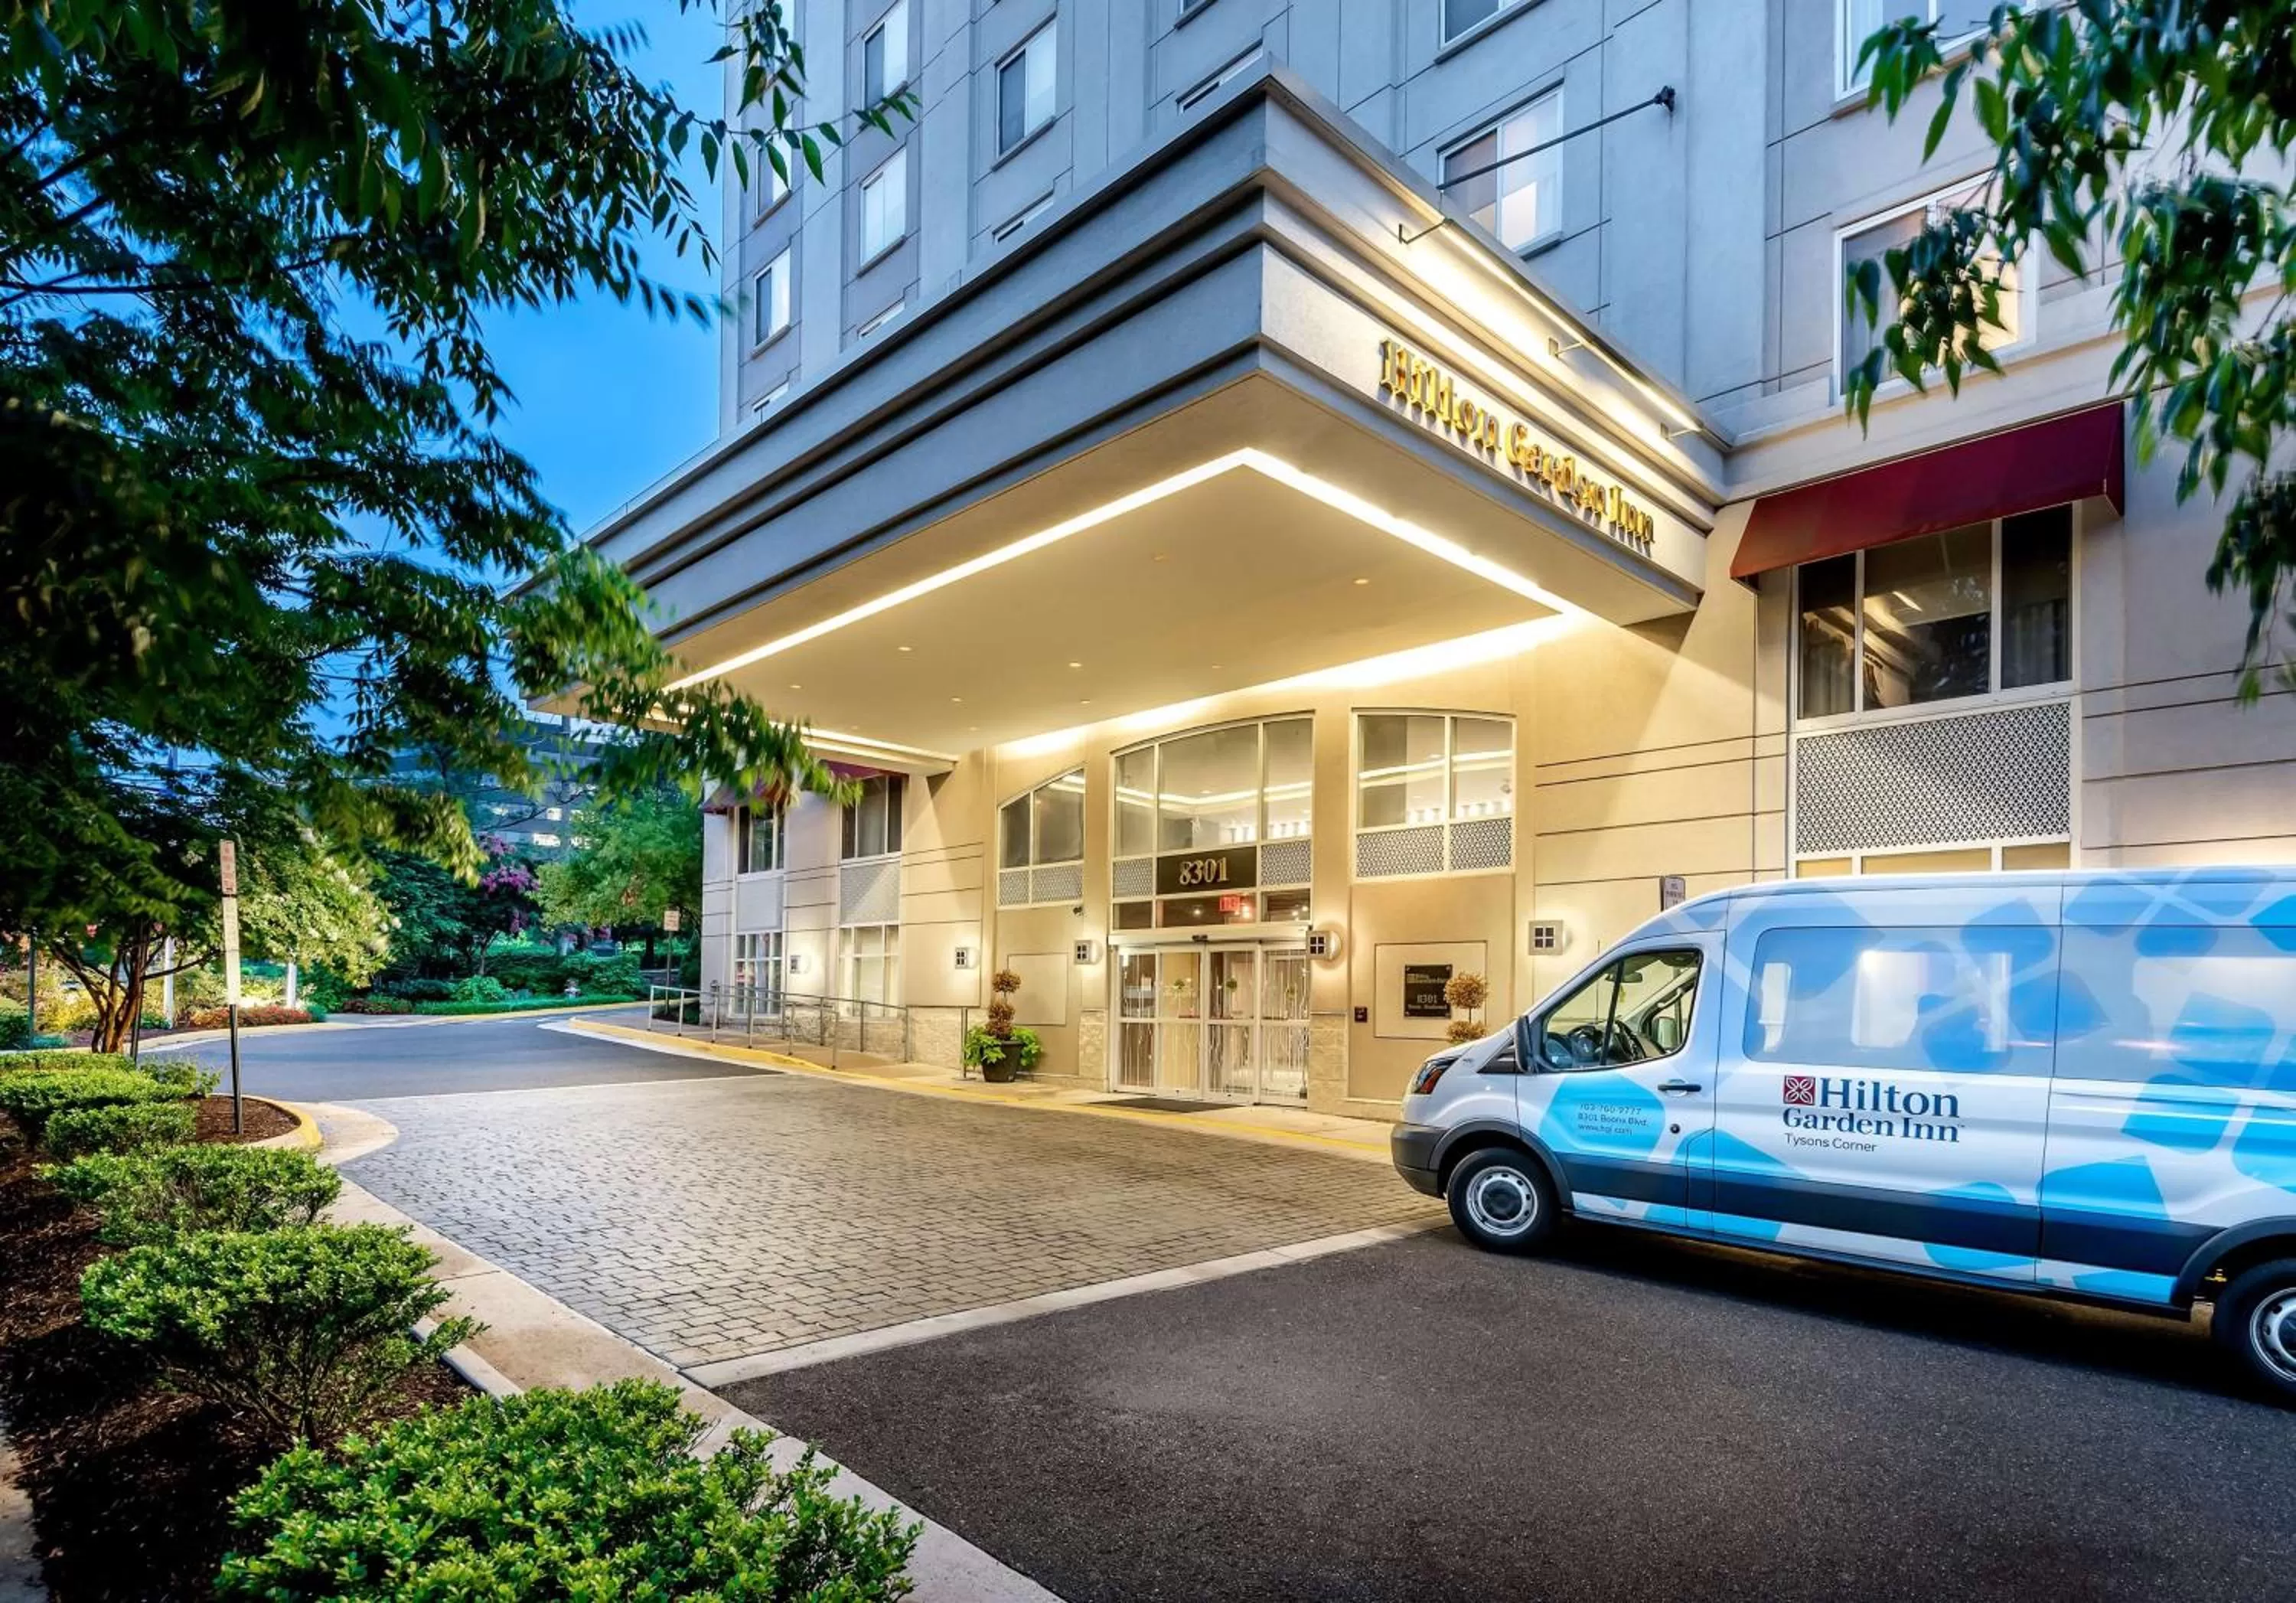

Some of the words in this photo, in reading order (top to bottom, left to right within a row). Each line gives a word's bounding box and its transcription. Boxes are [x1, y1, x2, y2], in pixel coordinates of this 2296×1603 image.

[1379, 338, 1502, 453] Hilton
[1505, 420, 1606, 519] Garden
[1609, 485, 1655, 544] Inn
[1179, 857, 1229, 886] 8301
[1820, 1077, 1960, 1118] Hilton
[1782, 1108, 1893, 1136] Garden
[1785, 1133, 1830, 1148] Tysons
[1832, 1138, 1877, 1152] Corner
